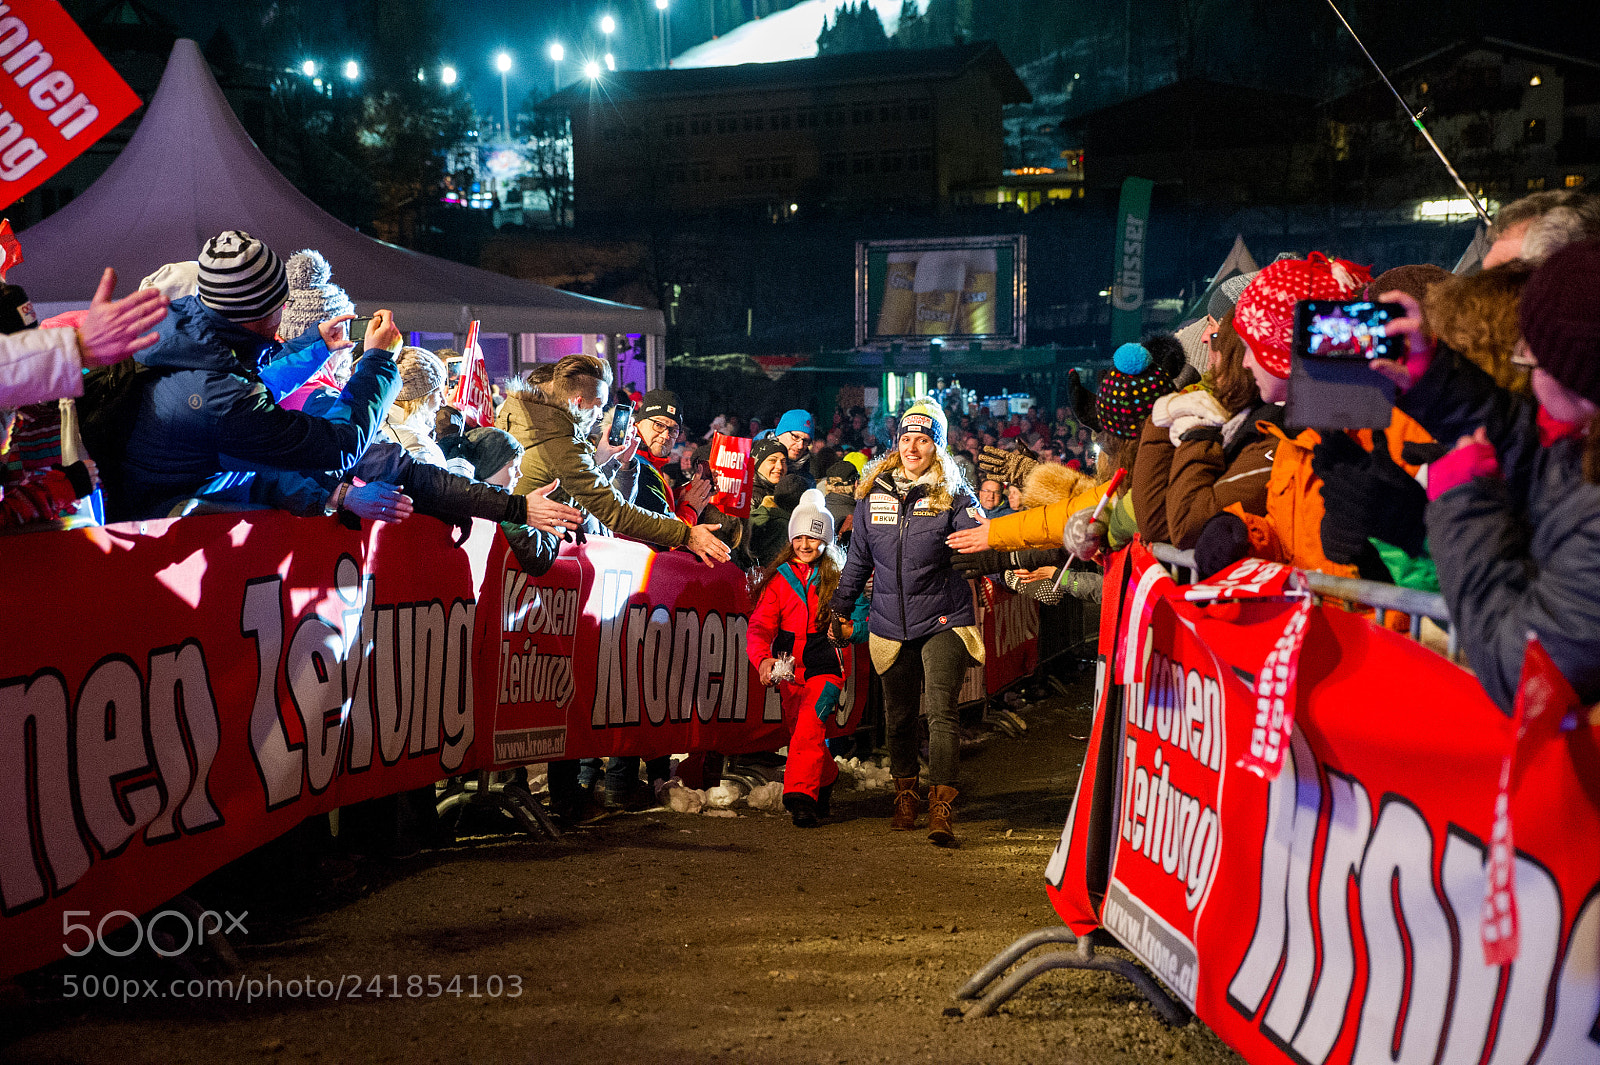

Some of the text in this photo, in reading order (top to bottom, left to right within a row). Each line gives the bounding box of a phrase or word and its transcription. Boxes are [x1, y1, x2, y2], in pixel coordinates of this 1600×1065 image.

[0, 4, 99, 140] onen
[1112, 213, 1144, 311] Gösser
[503, 569, 578, 636] Kronen
[591, 569, 748, 730] Kronen
[240, 552, 477, 812] Zeitung
[499, 637, 575, 708] Zeitung
[1112, 733, 1219, 912] Zeitung
